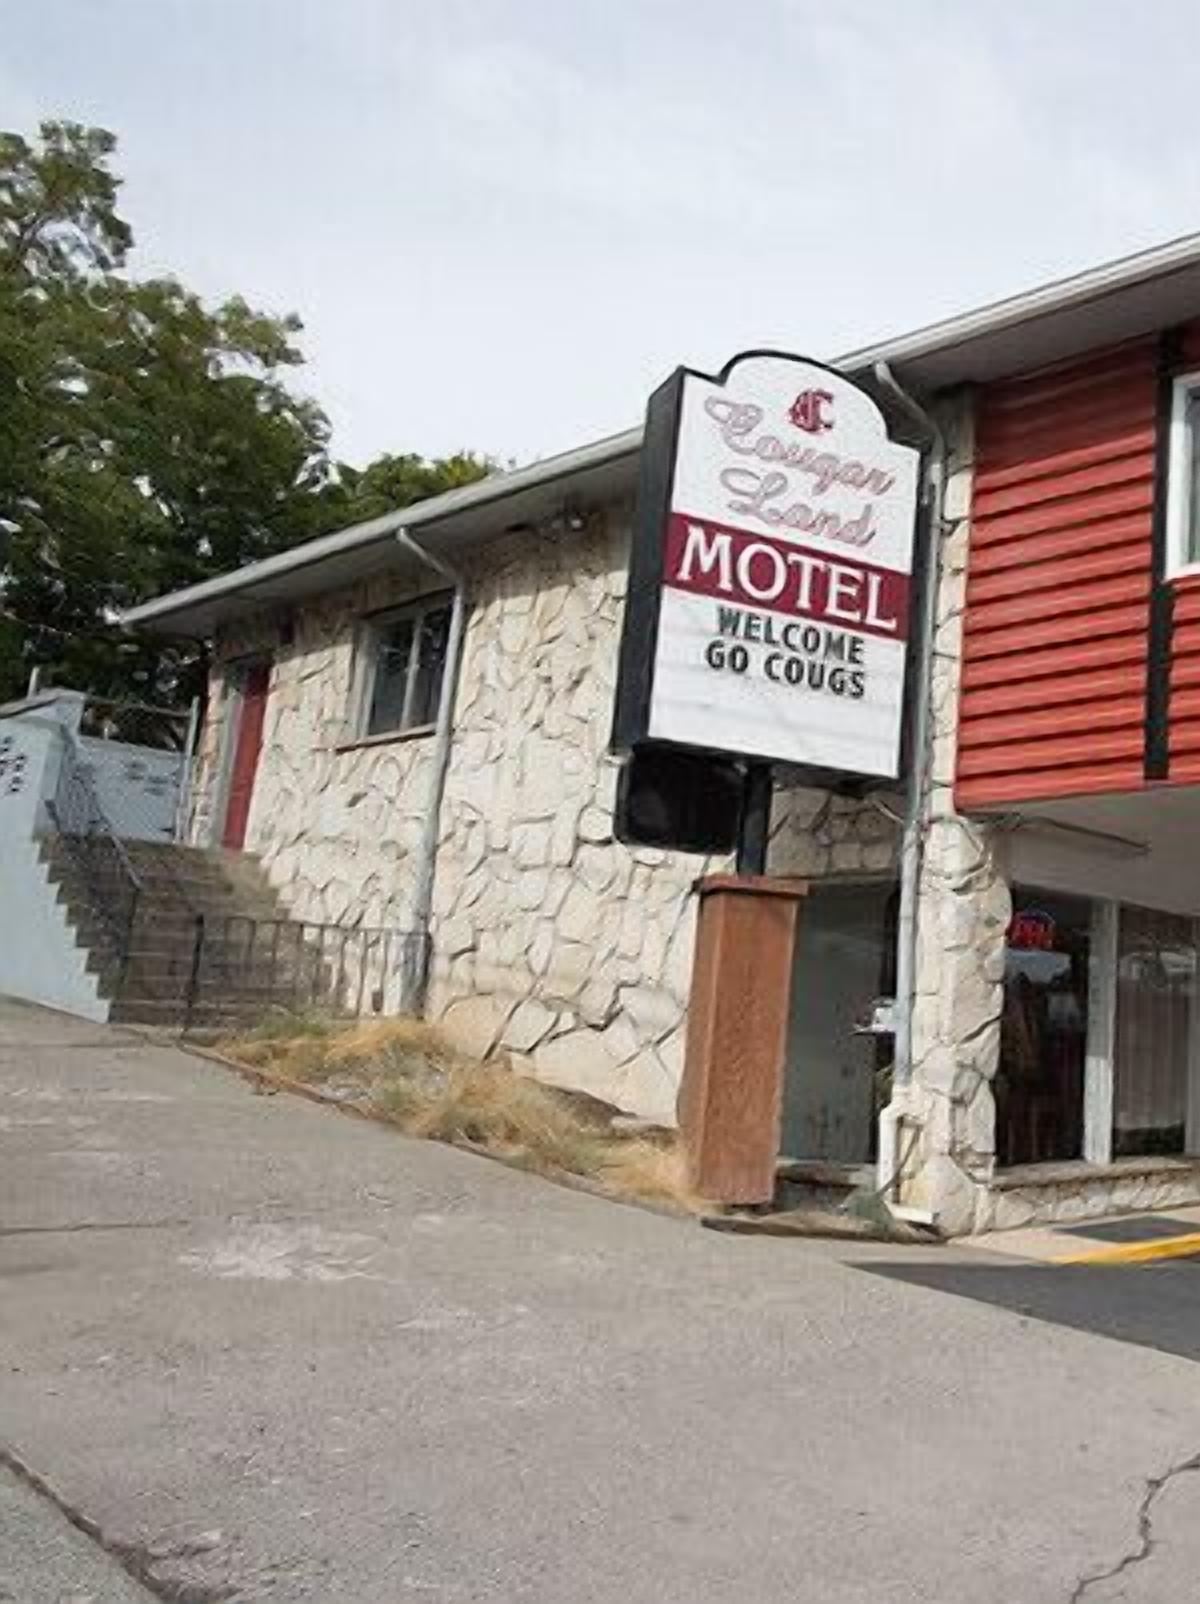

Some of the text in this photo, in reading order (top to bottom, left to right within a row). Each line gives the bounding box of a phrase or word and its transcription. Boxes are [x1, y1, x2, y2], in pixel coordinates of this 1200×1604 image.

[704, 396, 896, 496] Cougar
[720, 468, 876, 547] Land
[678, 527, 897, 629] MOTEL
[706, 639, 865, 699] GO COUGS
[717, 606, 864, 665] WELCOME
